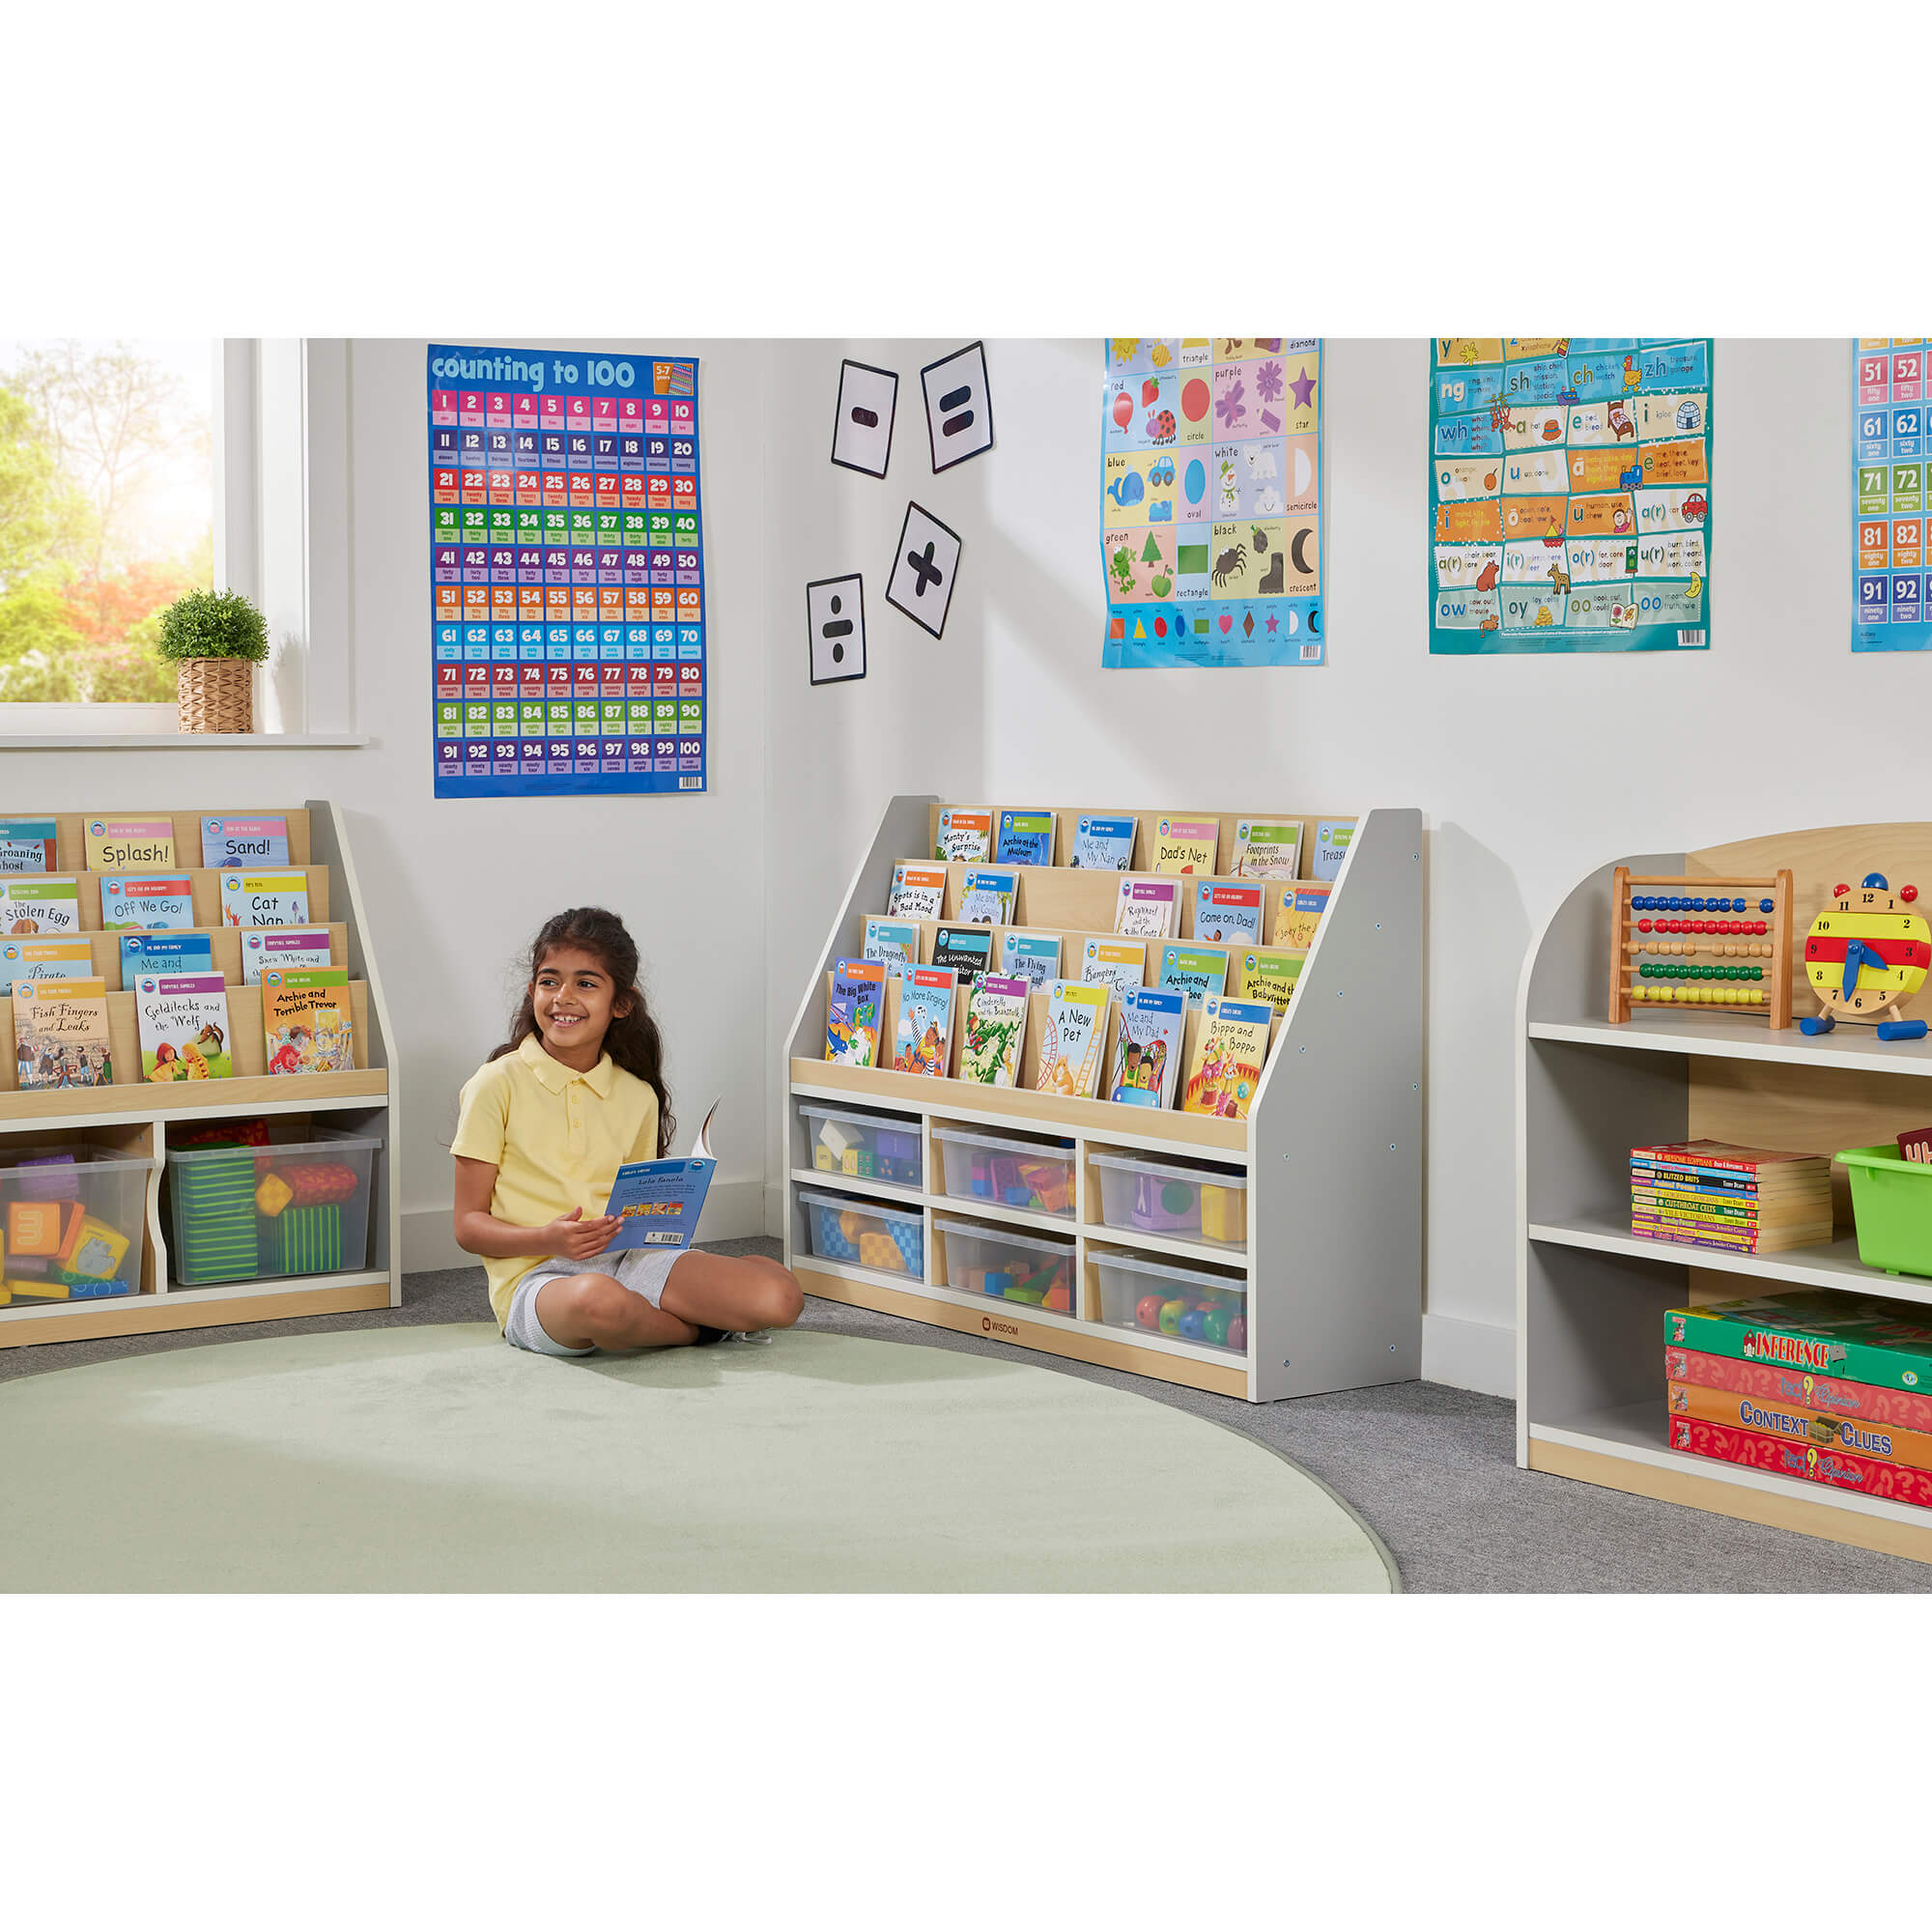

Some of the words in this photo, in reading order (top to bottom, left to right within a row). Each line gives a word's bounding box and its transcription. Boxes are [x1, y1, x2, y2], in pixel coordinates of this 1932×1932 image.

[1290, 340, 1316, 349] diamond
[1442, 339, 1451, 357] y
[1182, 353, 1208, 363] triangle
[432, 355, 545, 392] counting
[553, 362, 579, 384] to
[586, 360, 636, 387] 100
[656, 365, 670, 375] 5-7
[1573, 363, 1594, 384] ch
[1644, 355, 1667, 378] zh
[1864, 362, 1881, 382] 51
[1897, 358, 1918, 378] 52
[1214, 366, 1242, 382] purple
[1510, 371, 1529, 391] sh
[1110, 380, 1124, 391] red
[1441, 382, 1464, 402] ng
[1295, 420, 1309, 430] star
[1516, 421, 1526, 434] a
[1572, 415, 1582, 429] e
[1863, 416, 1881, 437] 61
[1896, 413, 1918, 434] 62
[1440, 419, 1467, 440] wh
[1186, 433, 1205, 441] circle
[1214, 446, 1238, 458] white
[1107, 458, 1125, 468] blue
[1440, 471, 1451, 485] o
[1510, 467, 1520, 480] u
[1863, 472, 1882, 491] 71
[1896, 469, 1918, 490] 72
[1286, 501, 1318, 512] semicircle
[1641, 503, 1666, 522] a(r)
[1186, 510, 1202, 519] oval
[1213, 524, 1237, 536] black
[1105, 532, 1129, 545] green
[1572, 550, 1595, 566] o(r)
[1640, 546, 1664, 564] u(r)
[1176, 588, 1208, 598] rectangle
[1289, 582, 1318, 592] crescent
[1863, 581, 1883, 601] 91
[1895, 580, 1918, 599] 92
[1440, 603, 1466, 616] ow
[1509, 601, 1528, 619] oy
[1571, 599, 1592, 613] oo
[443, 746, 458, 758] 91
[469, 745, 488, 758] 92
[496, 744, 515, 758] 93
[523, 744, 543, 757] 94
[551, 744, 569, 757] 95
[577, 743, 597, 756] 96
[605, 743, 623, 755] 97
[631, 742, 649, 755] 98
[656, 742, 674, 754] 99
[680, 741, 700, 754] 100
[943, 832, 970, 844] Monty's
[1003, 837, 1021, 847] Archie
[1022, 839, 1030, 848] at
[1082, 838, 1095, 850] Me
[1096, 840, 1109, 852] and
[225, 839, 271, 855] Sand!
[952, 841, 981, 852] Surprise
[1008, 846, 1033, 857] Museum
[1246, 843, 1279, 856] Footprints
[0, 847, 43, 863] roaning
[102, 843, 169, 867] Splash!
[1087, 852, 1098, 864] My
[1100, 853, 1115, 865] Nan
[1160, 846, 1185, 860] Dad's
[1188, 848, 1208, 864] Net
[1258, 857, 1268, 866] the
[1269, 857, 1290, 867] Snow
[251, 896, 279, 911] Cat
[894, 891, 912, 904] Spots
[913, 891, 920, 899] is
[1862, 894, 1874, 903] 12
[114, 901, 136, 917] Off
[139, 900, 156, 913] We
[159, 900, 184, 914] Go!
[899, 902, 914, 912] Bad
[915, 902, 933, 914] Mood
[1839, 901, 1849, 911] 11
[6, 905, 44, 922] Stolen
[48, 908, 71, 926] Egg
[1200, 911, 1221, 923] Come
[1236, 914, 1255, 929] Dad!
[1817, 921, 1830, 930] 10
[258, 955, 277, 965] Snow
[282, 953, 303, 964] White
[307, 955, 320, 964] and
[866, 948, 878, 958] The
[879, 946, 906, 963] Dragonfly
[936, 954, 947, 963] The
[948, 953, 983, 966] Unwanted
[141, 959, 159, 970] Me
[162, 956, 182, 968] and
[1014, 958, 1025, 968] The
[1027, 958, 1047, 975] Flying
[1166, 972, 1193, 985] Archie
[1193, 975, 1209, 988] and
[1246, 975, 1272, 989] Archie
[1272, 981, 1288, 993] and
[276, 991, 306, 1003] Archie
[308, 989, 327, 998] and
[836, 983, 846, 996] The
[847, 985, 857, 997] Big
[858, 981, 876, 993] White
[857, 994, 868, 1005] Box
[902, 993, 910, 1002] No
[911, 990, 925, 1001] More
[926, 991, 949, 1010] Singing!
[30, 1006, 55, 1019] Fish
[59, 1003, 99, 1020] Fingers
[145, 999, 200, 1020] Goldilocks
[204, 1004, 220, 1012] and
[273, 1003, 307, 1016] Terrible
[308, 1001, 337, 1010] Trevor
[155, 1022, 169, 1031] the
[171, 1015, 201, 1030] Wolf
[1059, 1010, 1065, 1024] A
[1068, 1009, 1092, 1027] New
[1127, 1012, 1140, 1024] Me
[1140, 1012, 1154, 1024] and
[39, 1024, 54, 1033] and
[55, 1018, 91, 1032] Leaks
[1132, 1026, 1144, 1038] My
[1146, 1025, 1159, 1037] Dad
[1210, 1021, 1236, 1037] Bippo
[1236, 1022, 1255, 1037] and
[1064, 1028, 1082, 1042] Pet
[1229, 1037, 1256, 1053] Boppo
[1662, 1173, 1685, 1181] BLITZED
[1700, 1204, 1717, 1213] CELTS
[1755, 1332, 1830, 1370] INFERENCE
[1780, 1378, 1803, 1397] Fact
[1814, 1383, 1861, 1408] Opinion
[1739, 1400, 1809, 1437] CONTEXT
[1840, 1421, 1893, 1456] CLUES
